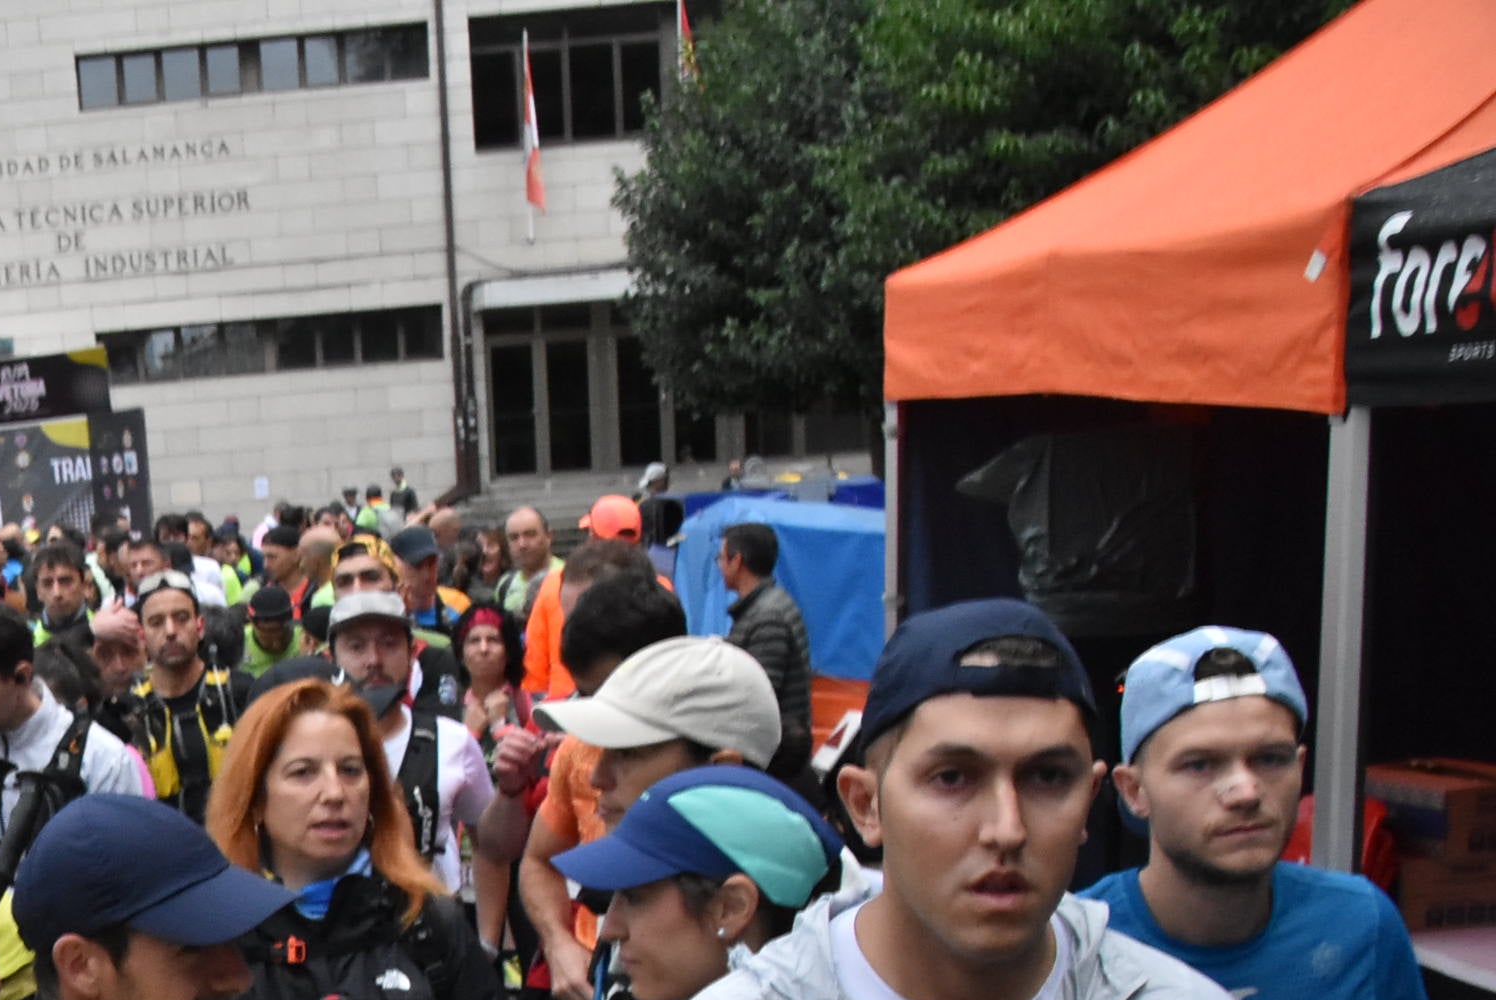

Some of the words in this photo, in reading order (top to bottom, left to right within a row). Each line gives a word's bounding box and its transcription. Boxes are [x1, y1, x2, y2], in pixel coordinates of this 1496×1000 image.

[59, 152, 84, 172] DE
[93, 139, 231, 168] SALAMANCA
[131, 189, 251, 220] SUPERIOR
[56, 231, 86, 252] DE
[83, 244, 234, 278] INDUSTRIAL
[1447, 340, 1496, 363] SPORTS
